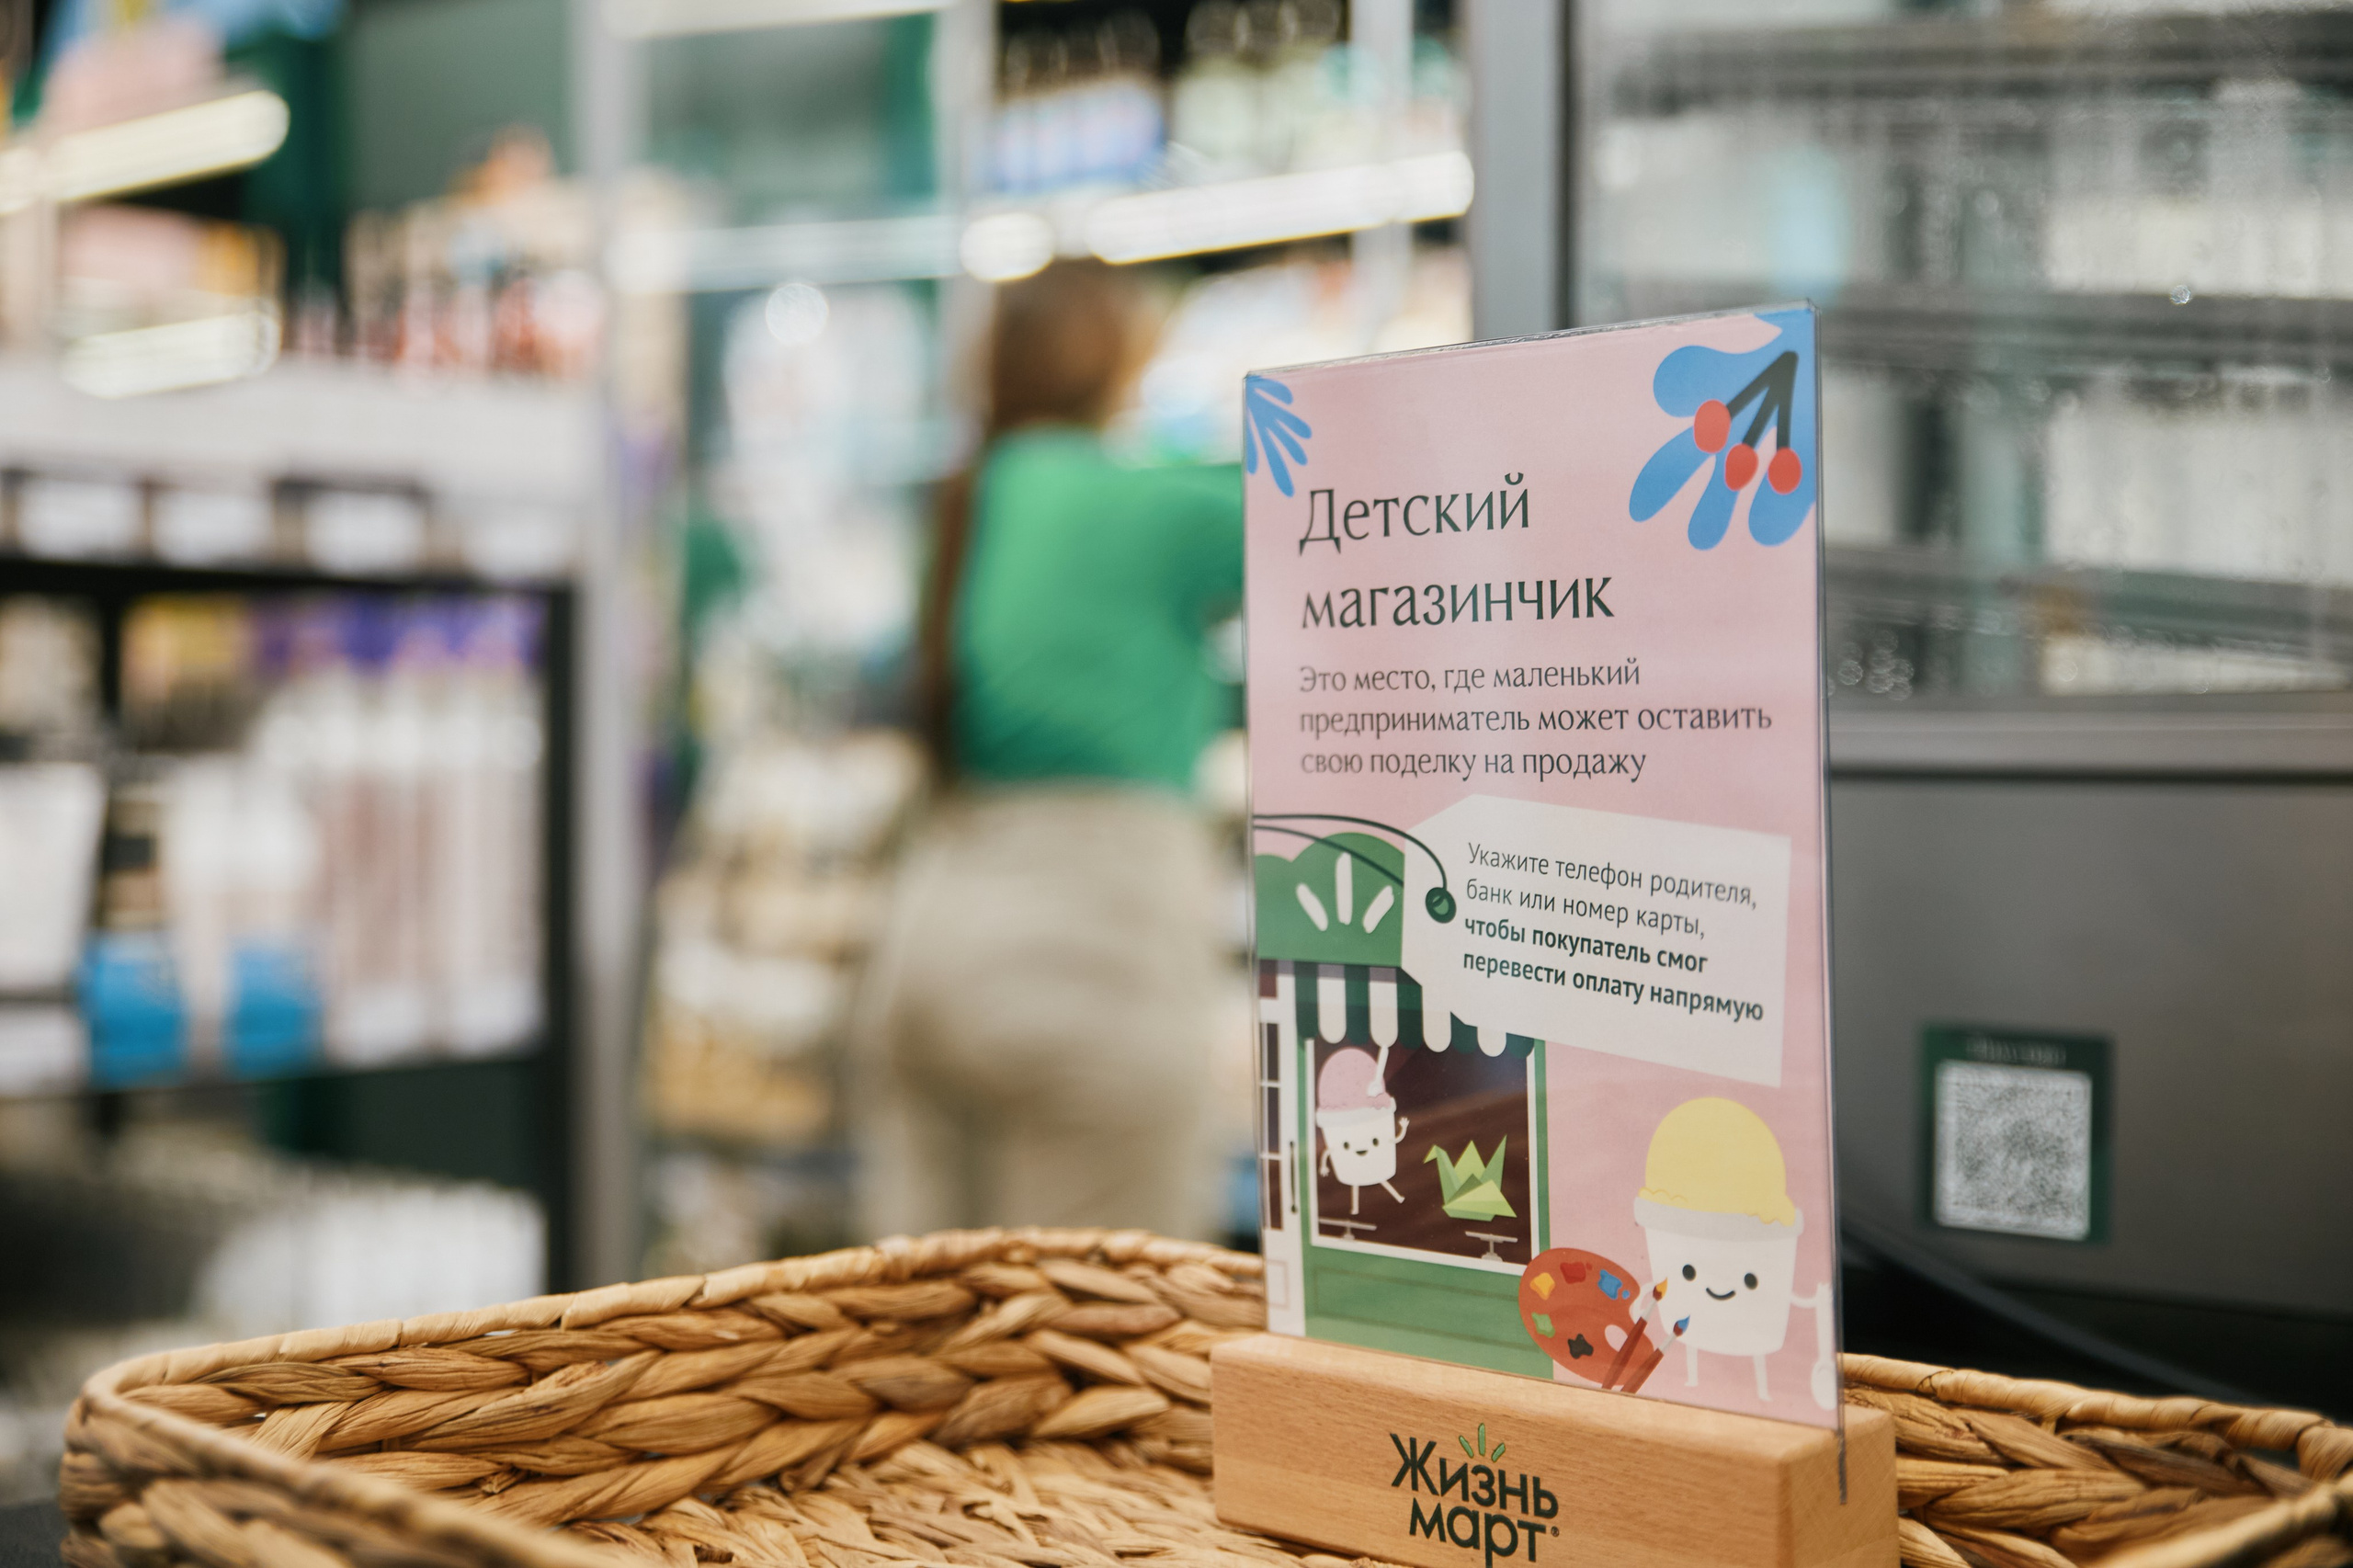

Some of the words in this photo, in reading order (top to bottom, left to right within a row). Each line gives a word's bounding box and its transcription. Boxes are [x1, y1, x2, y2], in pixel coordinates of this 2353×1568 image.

[1300, 472, 1529, 556] Детский
[1302, 576, 1615, 630] магазинчик
[1300, 665, 1347, 693] Это
[1353, 666, 1436, 692] место,
[1444, 667, 1485, 695] где
[1493, 657, 1640, 689] маленький
[1301, 709, 1529, 740] предприниматель
[1538, 709, 1629, 732] может
[1638, 707, 1772, 730] оставить
[1301, 753, 1363, 774] свою
[1370, 753, 1476, 782] поделку
[1484, 754, 1515, 774] на
[1522, 752, 1647, 783] продажу
[1468, 842, 1549, 875] Укажите
[1555, 858, 1643, 889] телефон
[1651, 873, 1756, 910] родителя,
[1466, 879, 1512, 905] банк
[1519, 890, 1555, 913] или
[1563, 896, 1628, 927] номер
[1636, 907, 1705, 940] карты,
[1465, 917, 1526, 943] чтобы
[1532, 928, 1651, 964] покупатель
[1657, 949, 1708, 973] смог
[1463, 950, 1565, 986] перевести
[1573, 969, 1644, 1005] оплату
[1650, 985, 1764, 1022] напрямую
[1390, 1432, 1559, 1519] Жизнь
